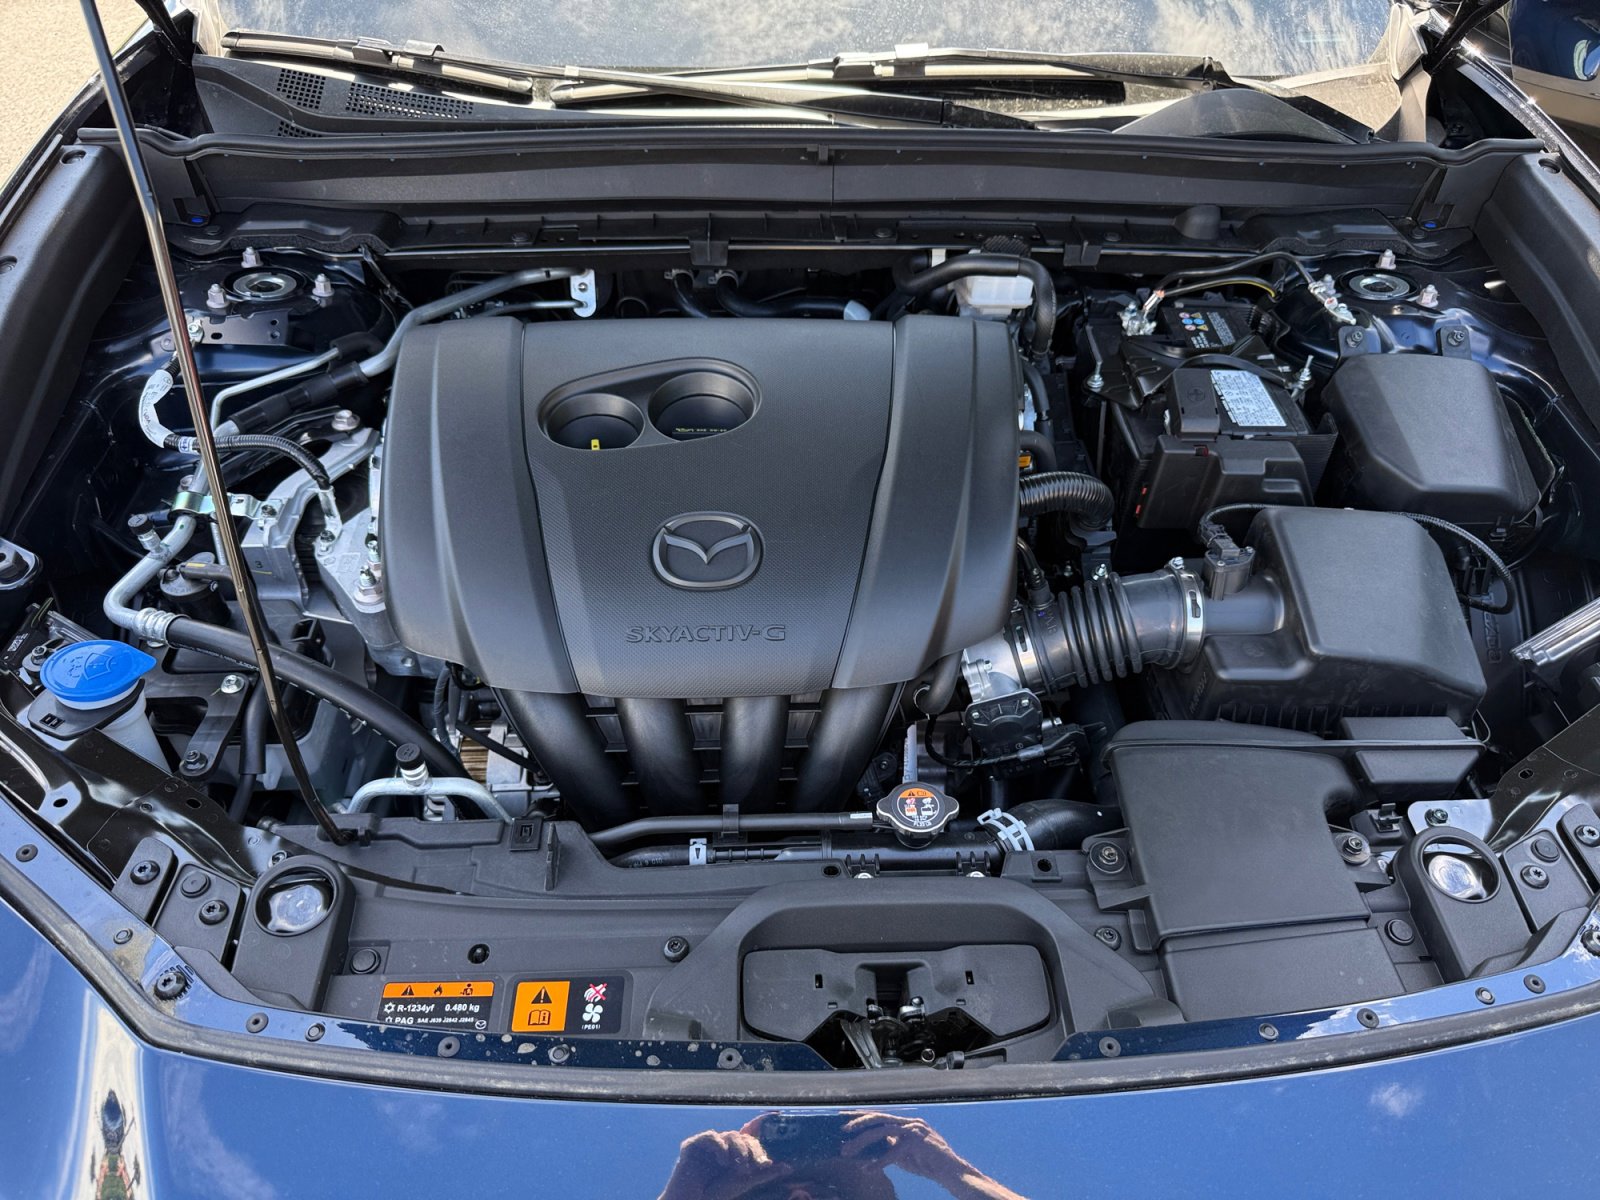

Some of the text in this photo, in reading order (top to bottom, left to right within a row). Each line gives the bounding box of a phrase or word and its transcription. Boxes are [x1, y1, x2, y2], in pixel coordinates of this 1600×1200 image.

[626, 625, 786, 643] SKYACTIV-G
[396, 1003, 480, 1013] R-1234yf 0.480 kg
[394, 1016, 414, 1025] PAG
